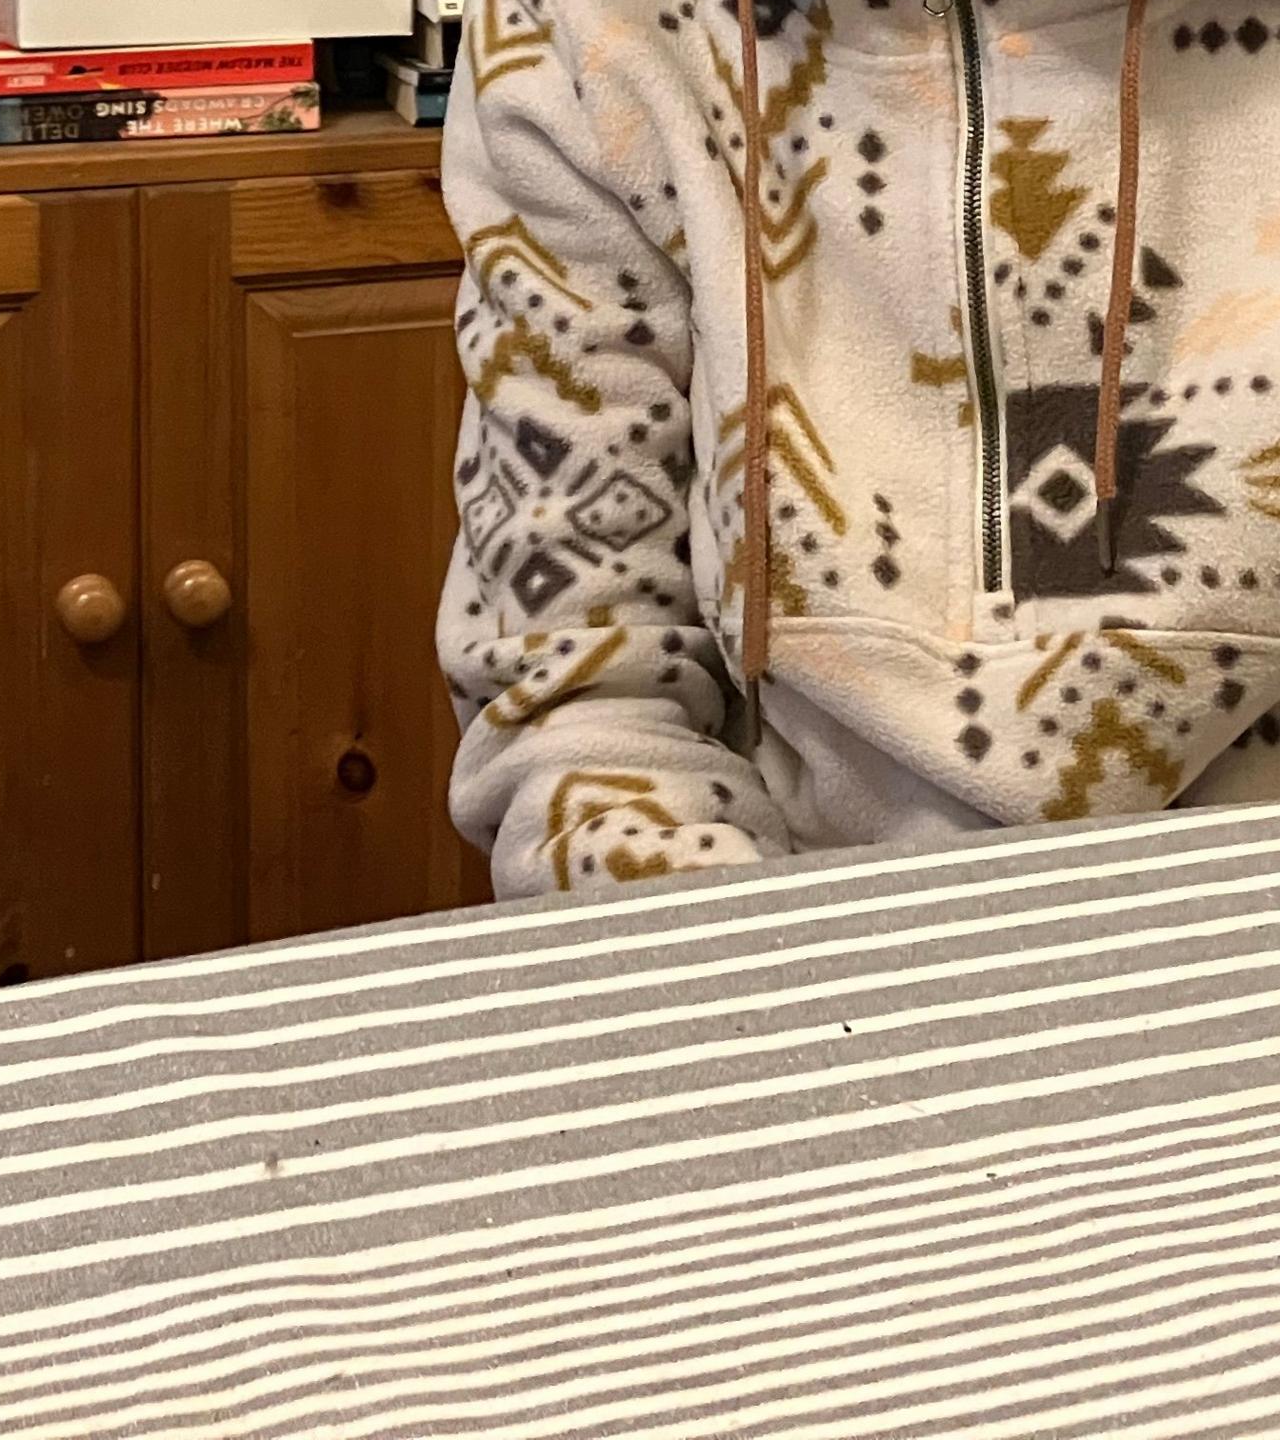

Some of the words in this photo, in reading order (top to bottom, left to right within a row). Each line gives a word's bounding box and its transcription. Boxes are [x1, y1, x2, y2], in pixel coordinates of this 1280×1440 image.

[217, 57, 275, 72] MARLOW
[280, 56, 303, 69] THE
[95, 100, 147, 118] SING
[153, 96, 265, 113] CRAWDADS
[126, 119, 165, 136] THE
[174, 116, 243, 133] WHERE
